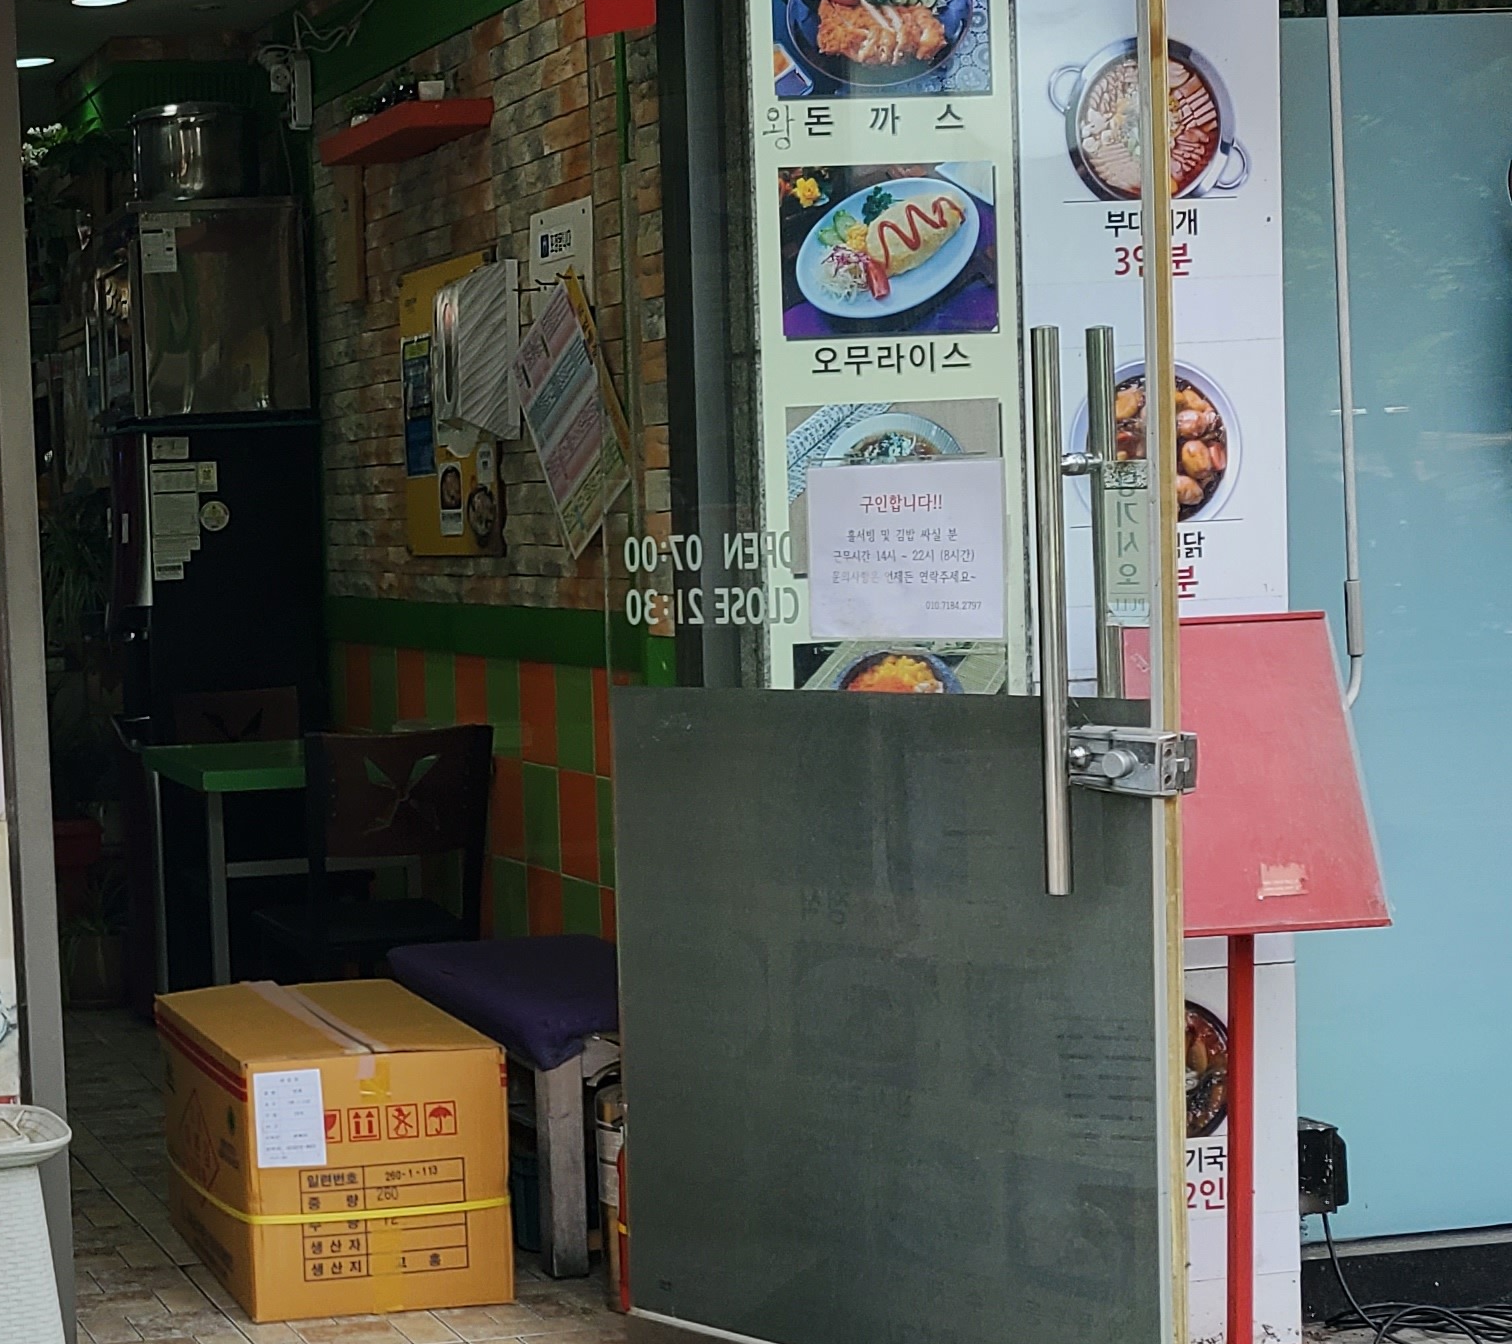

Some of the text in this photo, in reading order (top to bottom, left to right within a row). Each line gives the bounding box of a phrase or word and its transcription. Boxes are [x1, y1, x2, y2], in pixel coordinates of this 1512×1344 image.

[1105, 208, 1197, 238] 부대개
[811, 341, 972, 376] 오무라이스
[859, 493, 943, 513] 구인합니다!!
[847, 529, 875, 543] 홀서빙
[881, 528, 890, 542] 및
[896, 528, 915, 542] 김밥
[947, 528, 958, 541] 분
[833, 550, 870, 562] 근무시간
[876, 549, 896, 562] 14시
[912, 549, 935, 562] 22시
[940, 549, 975, 562] (8시간)
[886, 571, 913, 584] 언제든
[311, 1238, 361, 1255] 생산자
[311, 1260, 362, 1277] 생산지
